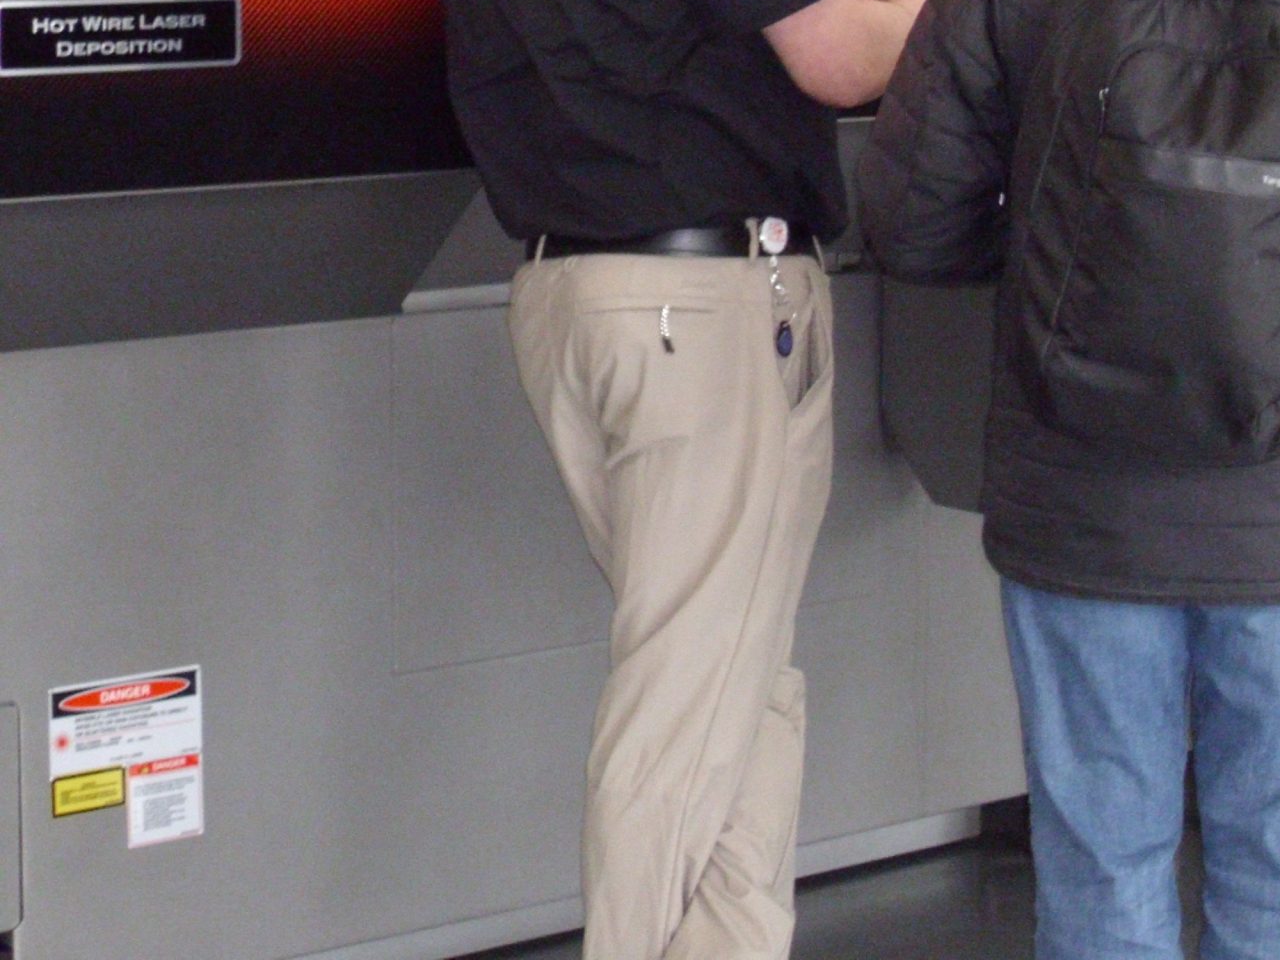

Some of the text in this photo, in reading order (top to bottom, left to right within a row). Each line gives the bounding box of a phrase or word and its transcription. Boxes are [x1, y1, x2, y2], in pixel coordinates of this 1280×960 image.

[32, 13, 206, 35] HOT WIRE LASER
[56, 38, 182, 58] DEPOSITION
[100, 684, 150, 704] DANGER
